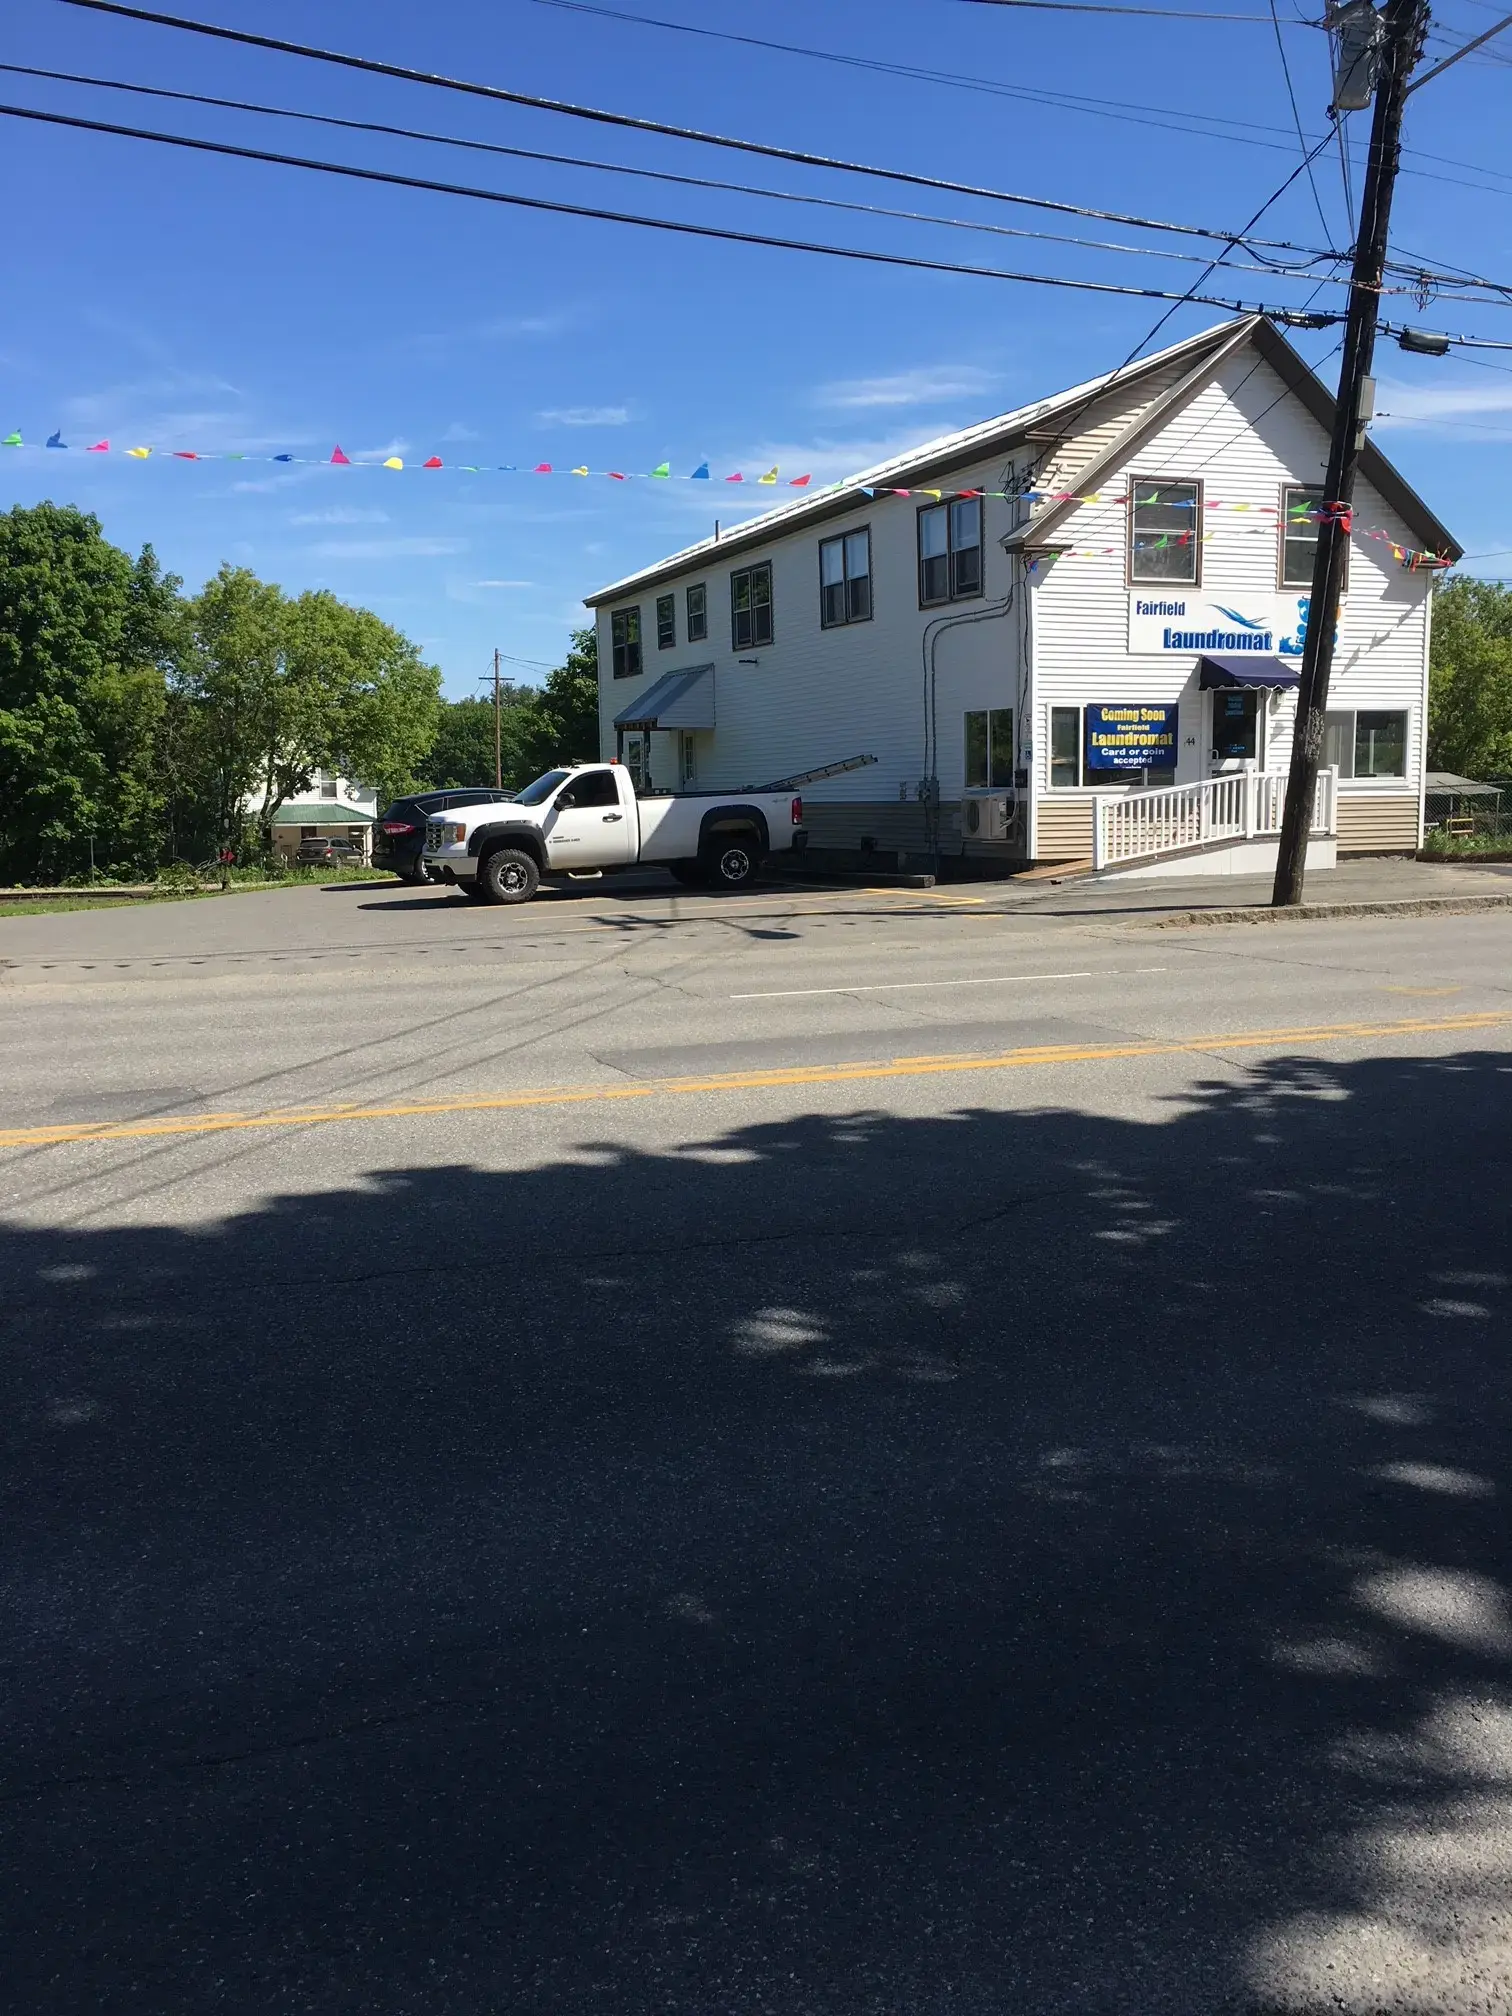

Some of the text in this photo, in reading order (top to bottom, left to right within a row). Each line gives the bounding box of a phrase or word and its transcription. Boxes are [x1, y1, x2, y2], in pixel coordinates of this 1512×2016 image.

[1136, 601, 1186, 616] Fairfield
[1163, 627, 1273, 650] Laundromat
[1101, 708, 1165, 722] Coming Soon
[1092, 732, 1174, 746] Laundromat
[1101, 748, 1126, 756] Card
[1142, 748, 1165, 756] coin
[1113, 756, 1153, 765] accepted
